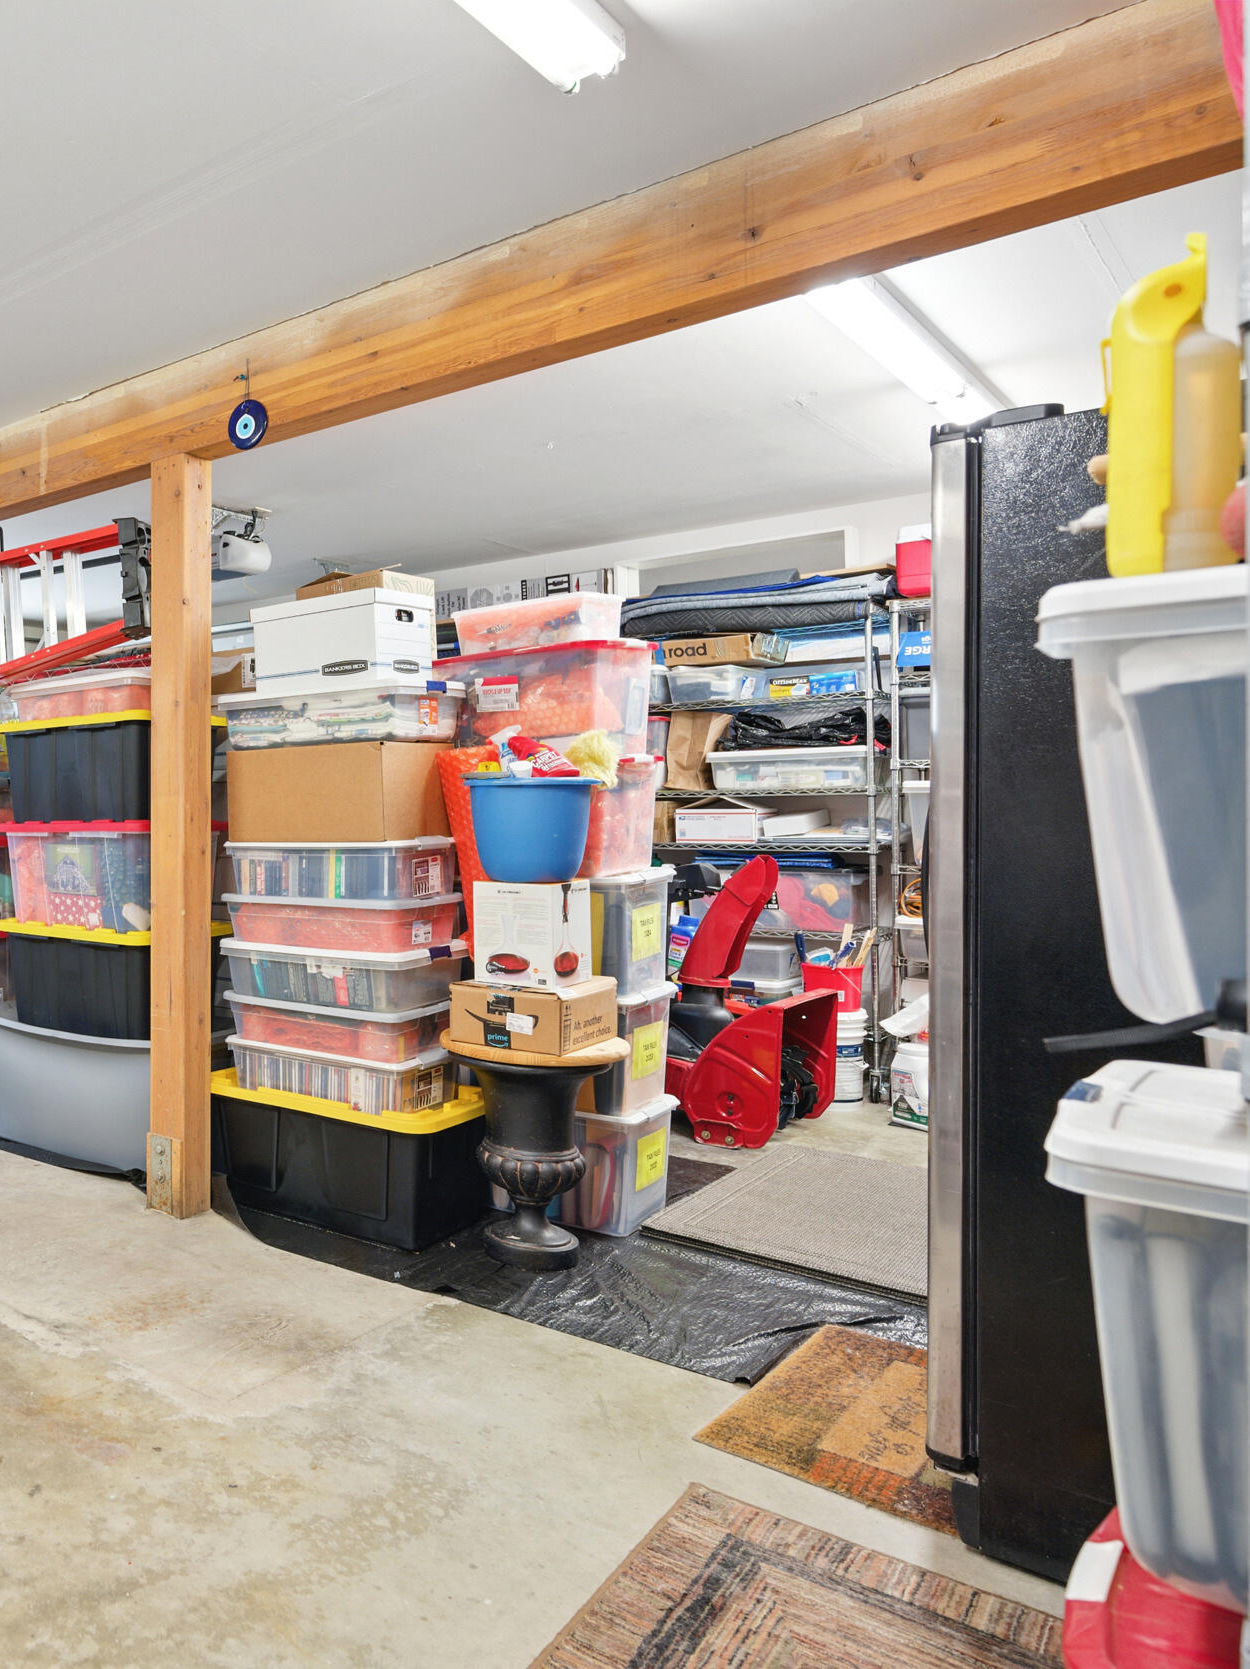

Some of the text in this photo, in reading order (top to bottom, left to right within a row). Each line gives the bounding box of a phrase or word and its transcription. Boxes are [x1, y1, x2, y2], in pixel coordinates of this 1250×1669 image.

[668, 643, 707, 658] road
[904, 645, 931, 656] RGE
[325, 664, 352, 673] BANKERS
[772, 678, 807, 686] OfficeMax
[583, 1016, 602, 1028] another
[487, 1033, 509, 1042] prime
[573, 1030, 595, 1045] excellent
